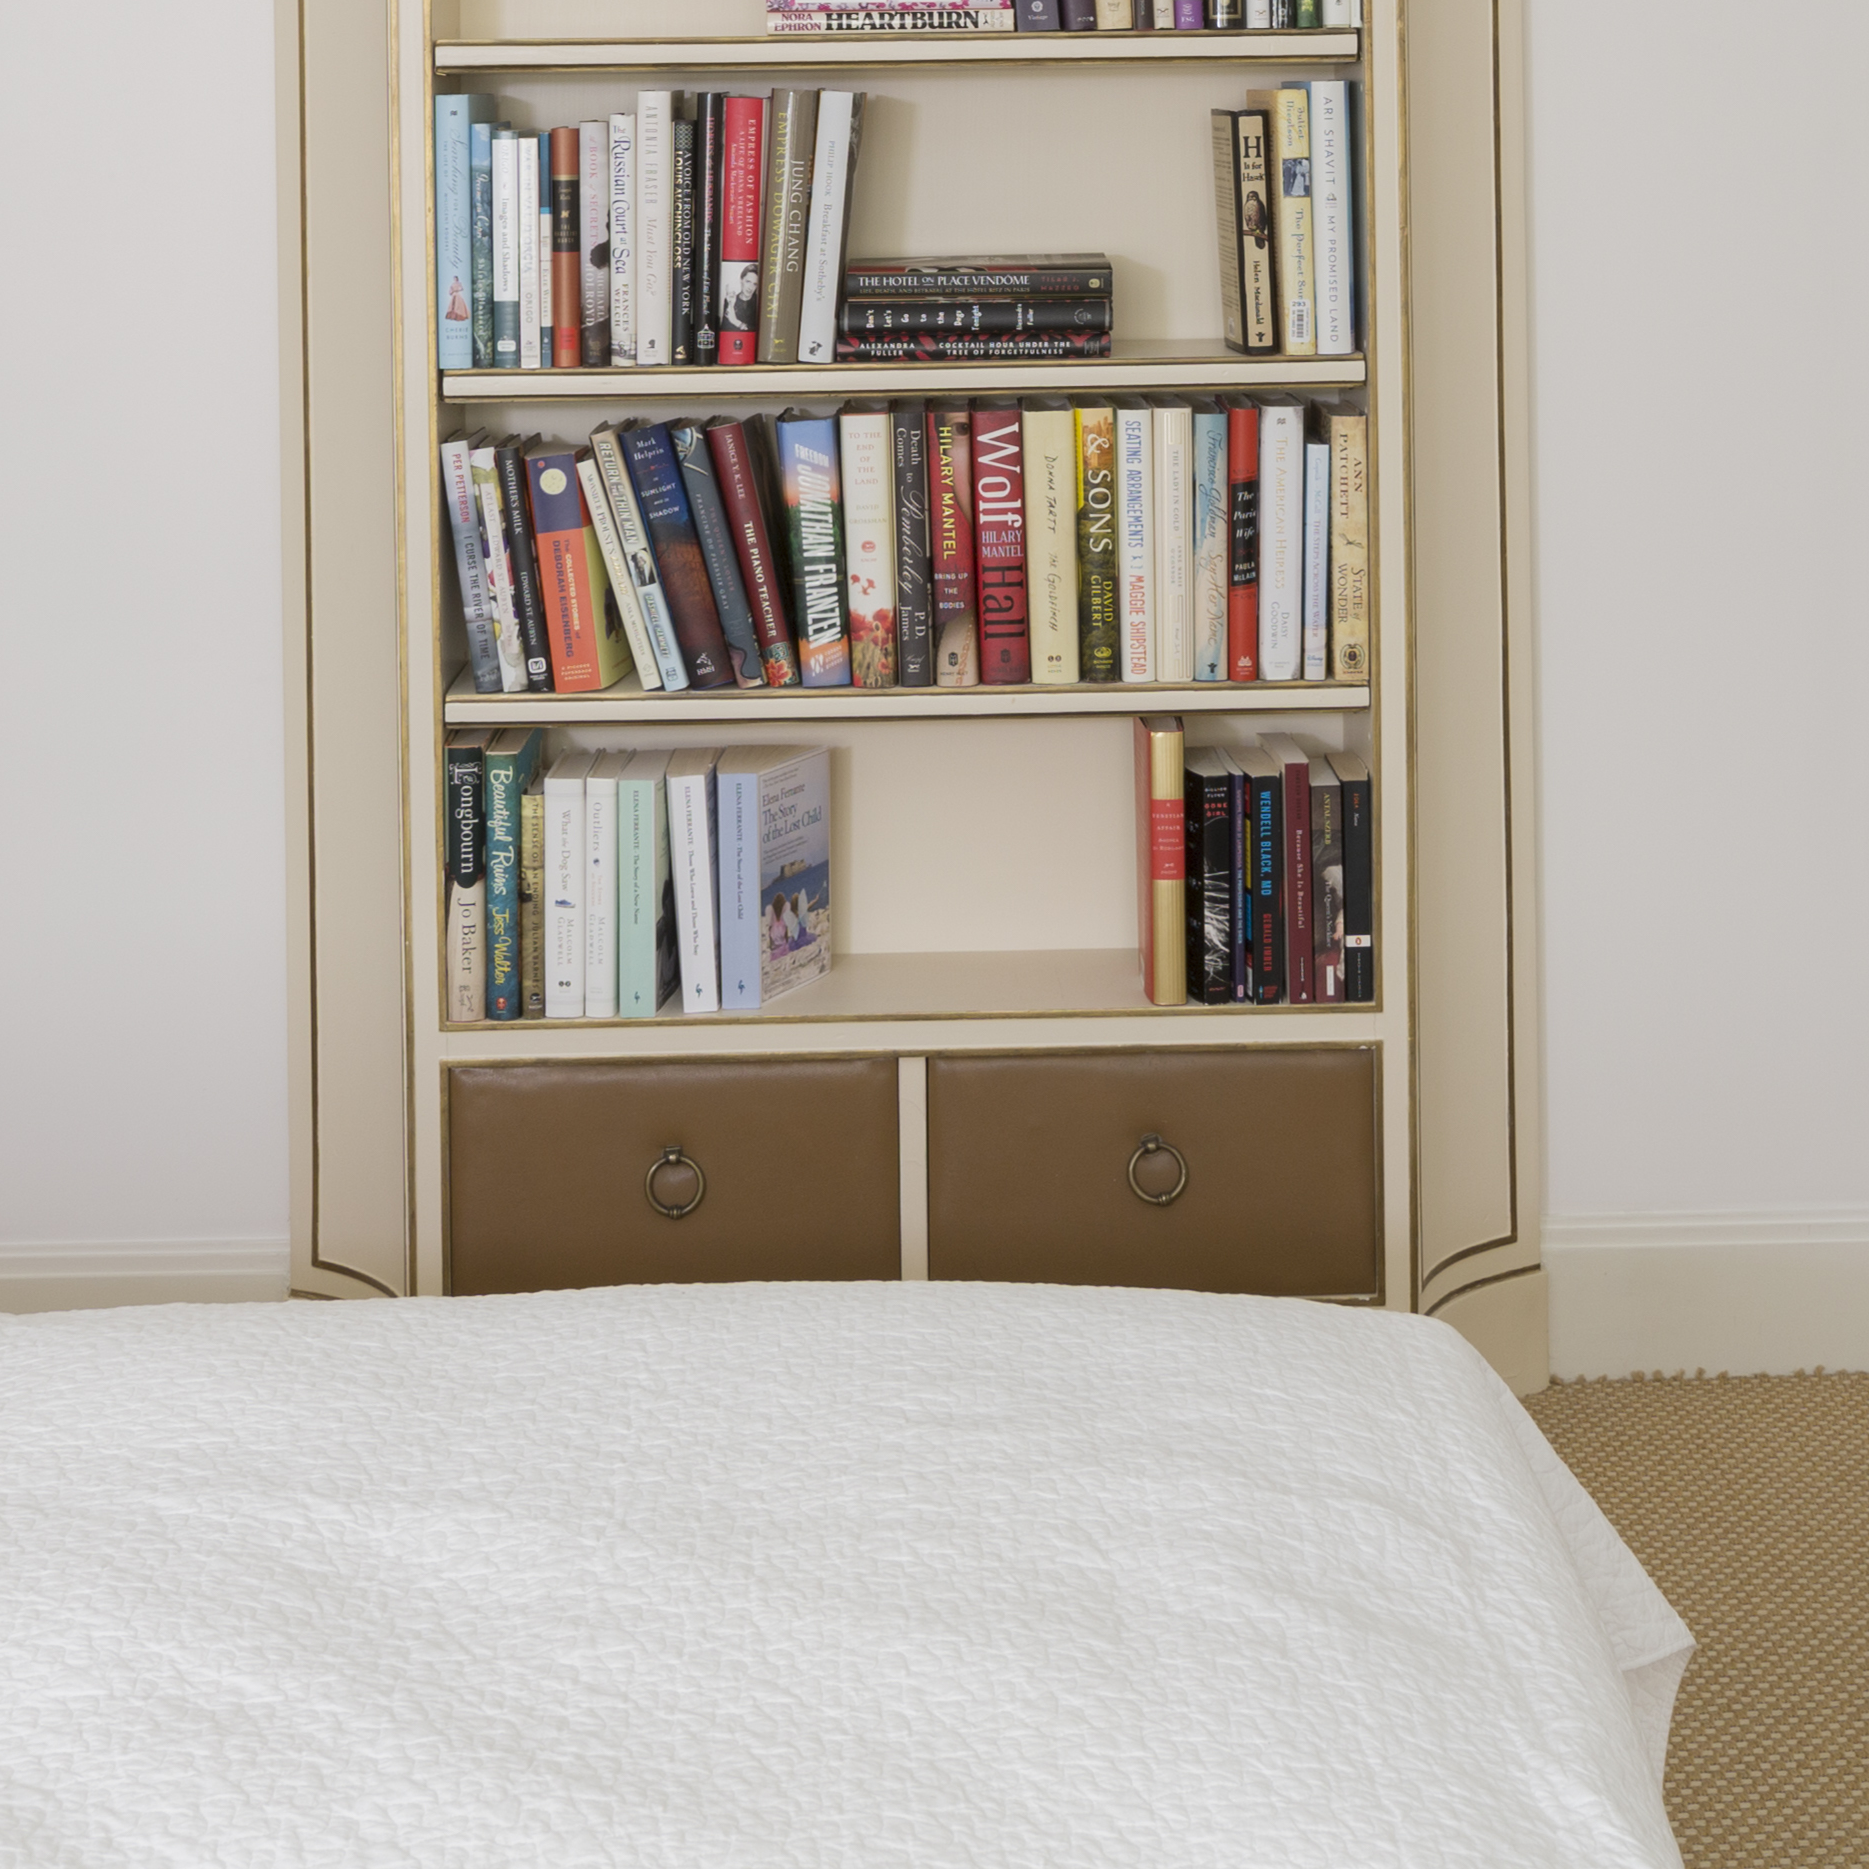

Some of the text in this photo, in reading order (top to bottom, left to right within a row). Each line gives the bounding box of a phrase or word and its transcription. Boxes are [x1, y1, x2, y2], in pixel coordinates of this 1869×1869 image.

[774, 22, 821, 31] EPHRON
[781, 13, 813, 22] NORA
[825, 11, 980, 31] HEARTBURN
[682, 161, 691, 195] VOICE
[673, 151, 682, 268] LOUIS AUCHINCLOSS
[682, 198, 691, 229] FROM
[767, 112, 789, 319] EMPRESS DOWAGER CIXI
[786, 160, 805, 273] JUNG CHANG
[1323, 97, 1339, 342] ARI SHAVIT MY PROMISED LAND
[500, 198, 510, 292] Images and Shadows
[682, 232, 691, 255] OLD
[682, 258, 691, 283] NEW
[858, 276, 881, 287] THE
[883, 276, 920, 286] HOTEL
[938, 275, 970, 286] PLACE
[972, 274, 1030, 286] VENDÔME
[681, 285, 691, 315] YORK
[860, 342, 915, 350] ALEXANDRA
[896, 428, 906, 467] Comes
[910, 430, 921, 465] Death
[452, 454, 470, 523] PER PETTERSON
[905, 472, 914, 482] to
[939, 427, 956, 560] HILARY MANTEL
[977, 422, 1022, 528] Wolf
[1087, 433, 1112, 553] & SONS
[1339, 433, 1349, 519] PATCHETT
[1354, 458, 1363, 493] ANN
[504, 460, 523, 535] MOTHER'S MILK
[898, 486, 925, 595] Pemberley
[981, 530, 1023, 543] HILARY
[982, 545, 1024, 558] MANTEL
[1125, 420, 1147, 675] SEATING ARRANGEMENTS MAGGIE SHIPSTEAD
[796, 464, 842, 649] JONATHAN FRANZEN
[552, 540, 574, 658] DEBORAH EISENBERG
[743, 521, 776, 638] THE PIANO TEACHER
[982, 564, 1025, 640] Hall
[899, 603, 911, 641] James
[914, 611, 926, 639] P. D.
[561, 810, 571, 836] What
[592, 802, 602, 851] Outliers
[1260, 791, 1271, 838] WENDELL
[449, 763, 482, 974] Longbourn Jo Baker
[487, 766, 514, 986] Beautiful Ruins Jess Walter
[559, 850, 570, 871] Dog
[561, 873, 571, 891] Saw
[1261, 881, 1272, 896] MD
